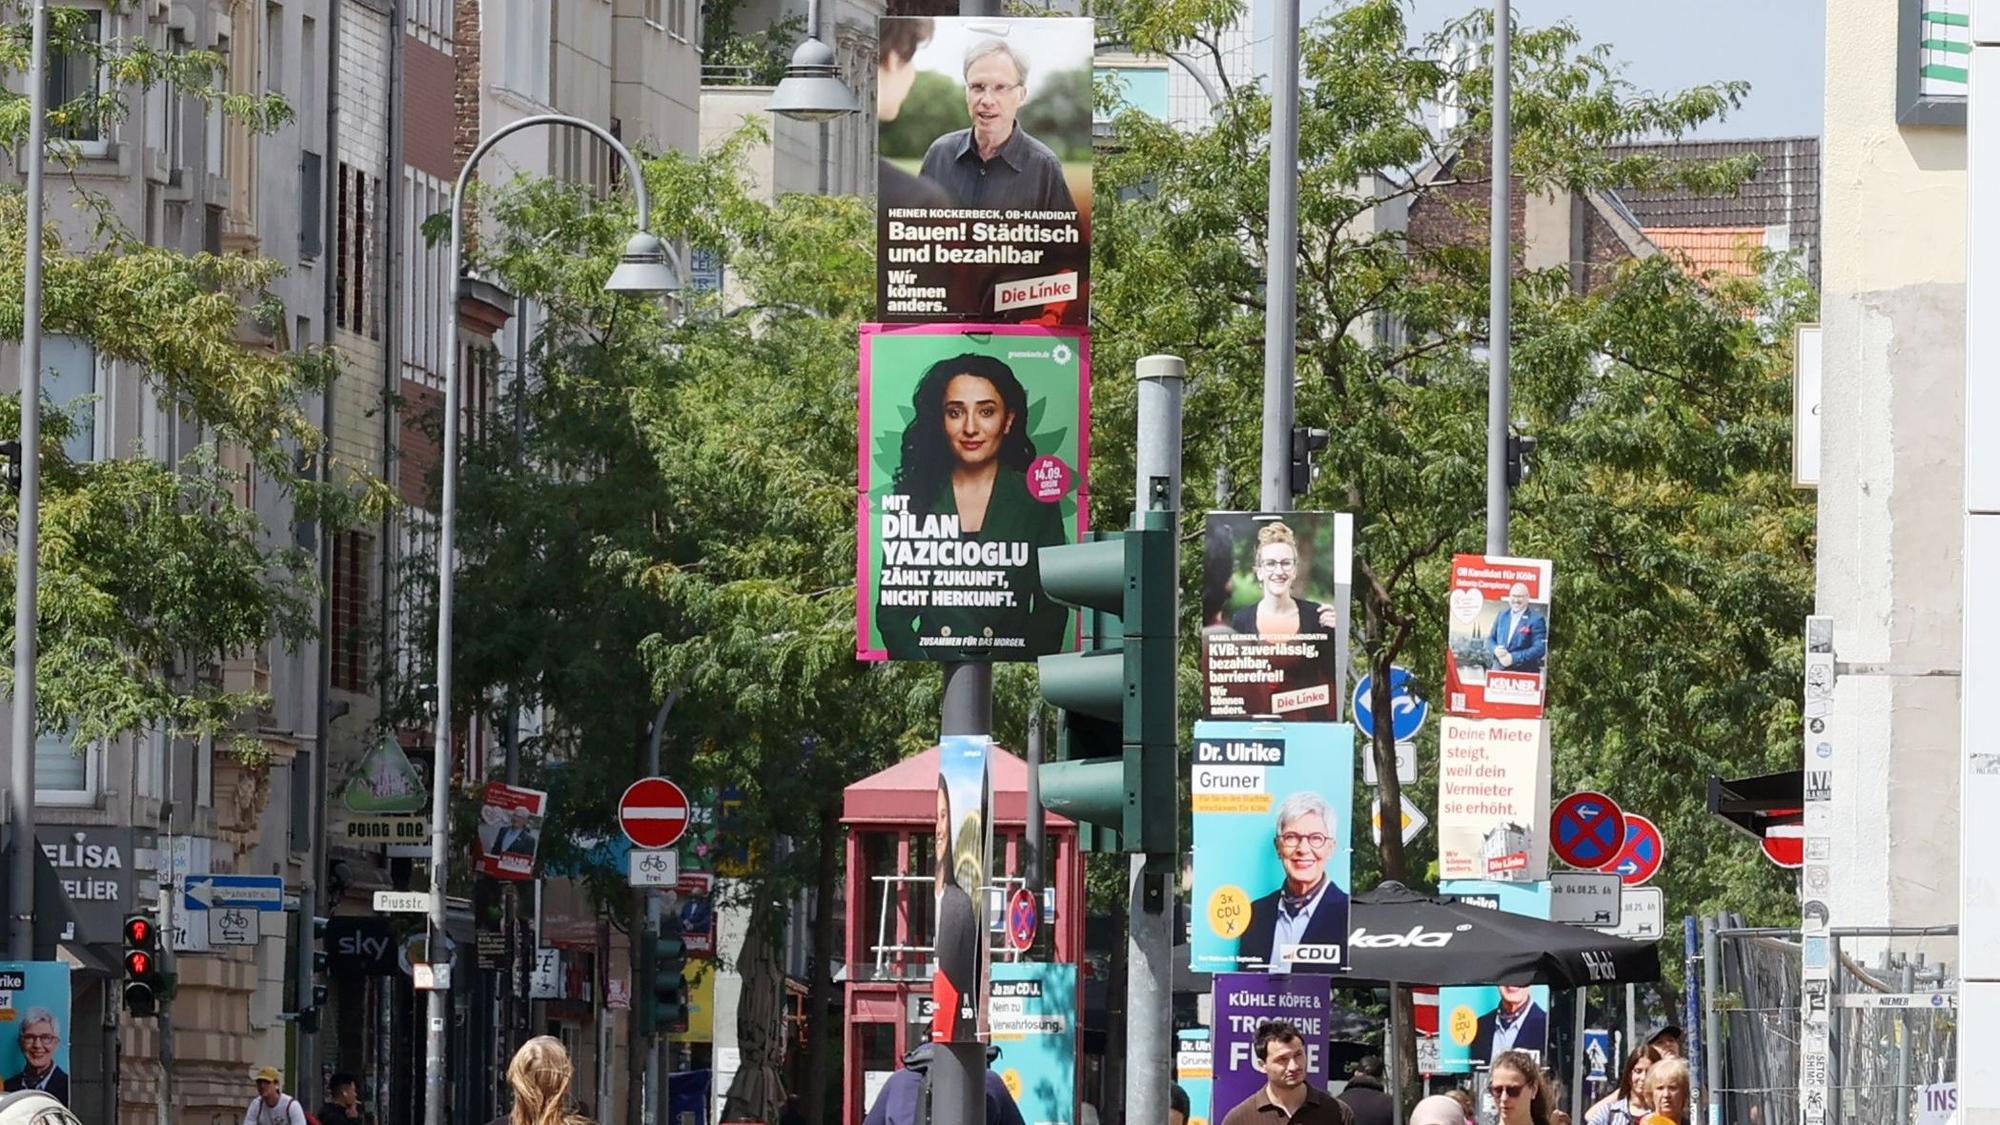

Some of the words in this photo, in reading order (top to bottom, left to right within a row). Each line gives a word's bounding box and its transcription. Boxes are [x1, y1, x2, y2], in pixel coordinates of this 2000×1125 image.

[888, 208, 927, 219] HEINER
[929, 208, 1004, 221] KOCKERBECK,
[1005, 209, 1077, 221] OB-KANDIDAT
[888, 221, 967, 241] Bauen!
[971, 222, 1079, 243] Städtisch
[888, 244, 931, 263] und
[934, 244, 1044, 264] bezahlbar
[888, 269, 918, 285] Wir
[887, 283, 946, 299] können
[1001, 287, 1026, 304] Die
[1030, 281, 1072, 300] Linke
[887, 298, 948, 313] anders.
[1034, 467, 1063, 482] 14.09.
[881, 494, 911, 511] MIT
[881, 541, 1029, 567] YAZICIOGLU
[881, 566, 931, 587] ZÄHLT
[933, 569, 1009, 590] ZUKUNFT,
[881, 589, 929, 606] NICHT
[932, 590, 1018, 608] HERKUNFT.
[919, 636, 961, 647] ZUSAMMEN
[962, 635, 978, 647] FÜR
[978, 637, 993, 647] DAS
[1209, 642, 1239, 657] KVB:
[1241, 642, 1319, 659] zuverlässig,
[1209, 657, 1272, 670] bezahlbar,
[1209, 669, 1284, 683] barrierefrei!
[1210, 685, 1228, 697] Wir
[1210, 705, 1247, 715] anders.
[1277, 698, 1294, 708] Die
[1448, 726, 1486, 740] Deine
[1488, 727, 1533, 742] Miete
[1199, 742, 1223, 762] Dr.
[1226, 742, 1281, 762] Ulrike
[1446, 746, 1489, 761] steigt,
[1446, 765, 1472, 777] weil
[1475, 764, 1506, 778] dein
[1199, 771, 1260, 789] Gruner
[1445, 782, 1513, 797] Vermieter
[1444, 802, 1462, 814] sie
[1465, 802, 1517, 816] erhöht.
[646, 873, 662, 882] frei
[380, 895, 424, 910] Piusstr.
[1220, 894, 1234, 905] 3x
[1216, 905, 1241, 919] CDU
[338, 929, 390, 961] sky
[1296, 947, 1337, 960] CDU
[1229, 991, 1276, 1007] KÜHLE
[1278, 992, 1312, 1008] KÖPFE
[1313, 996, 1321, 1008] &
[1011, 1003, 1021, 1012] zu
[992, 1020, 1063, 1034] Verwahrlosung.
